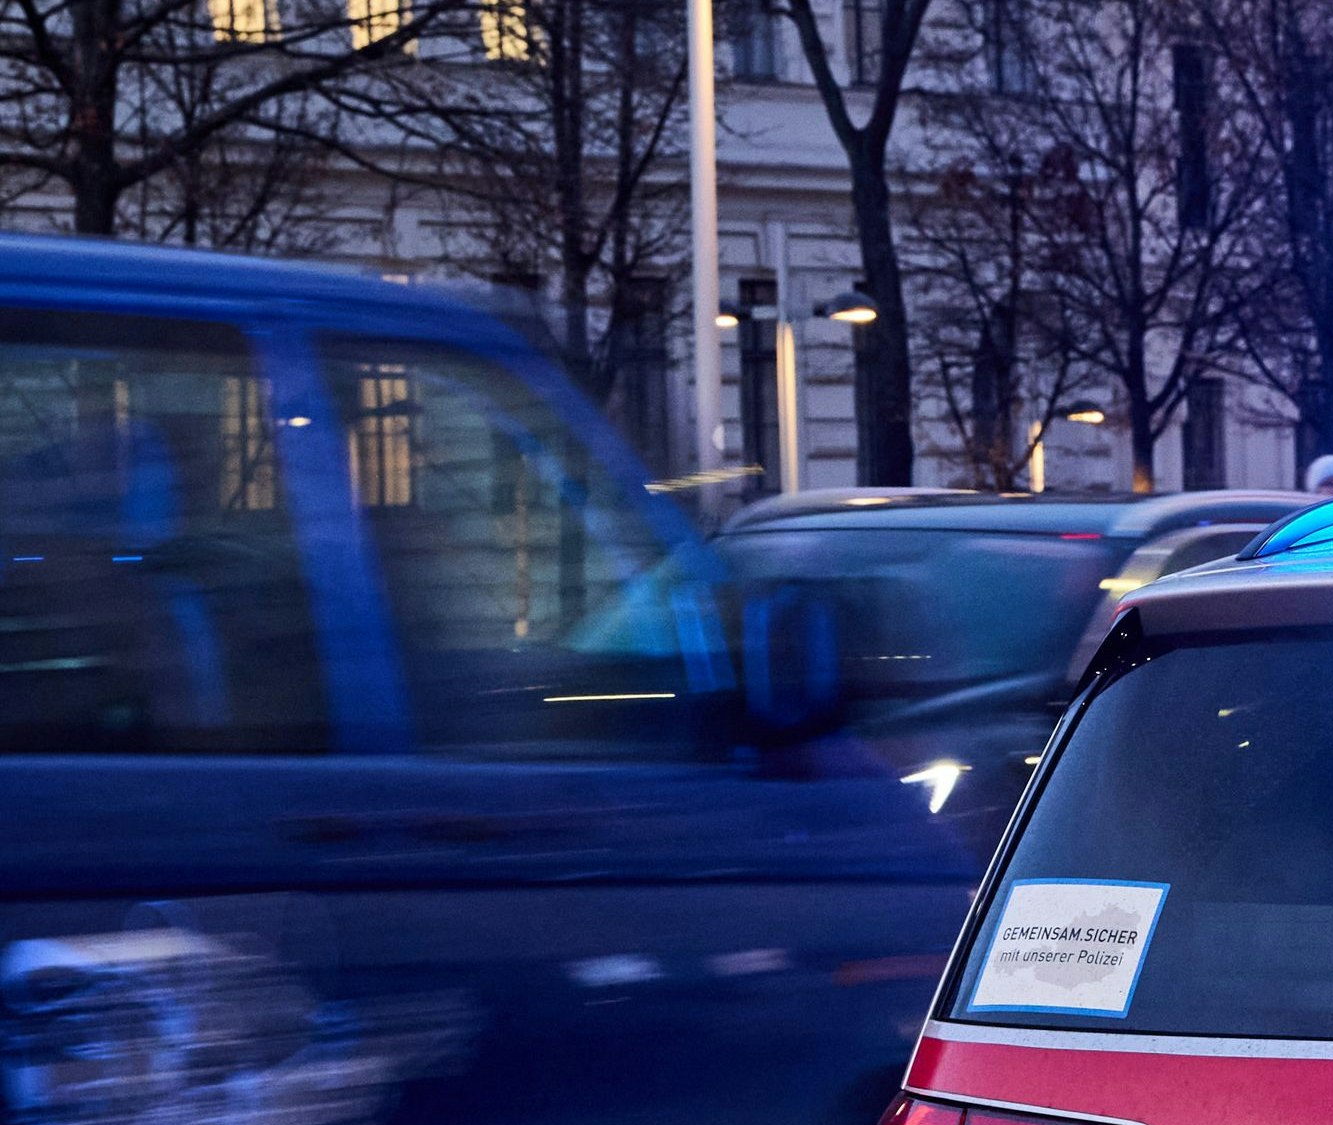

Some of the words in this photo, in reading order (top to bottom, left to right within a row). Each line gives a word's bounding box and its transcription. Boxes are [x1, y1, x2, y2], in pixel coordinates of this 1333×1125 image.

[1002, 926, 1138, 945] GEMEINSAM.SICHER
[1000, 949, 1020, 962] mit
[1023, 951, 1074, 963] unserer
[1077, 950, 1124, 966] Polizei
